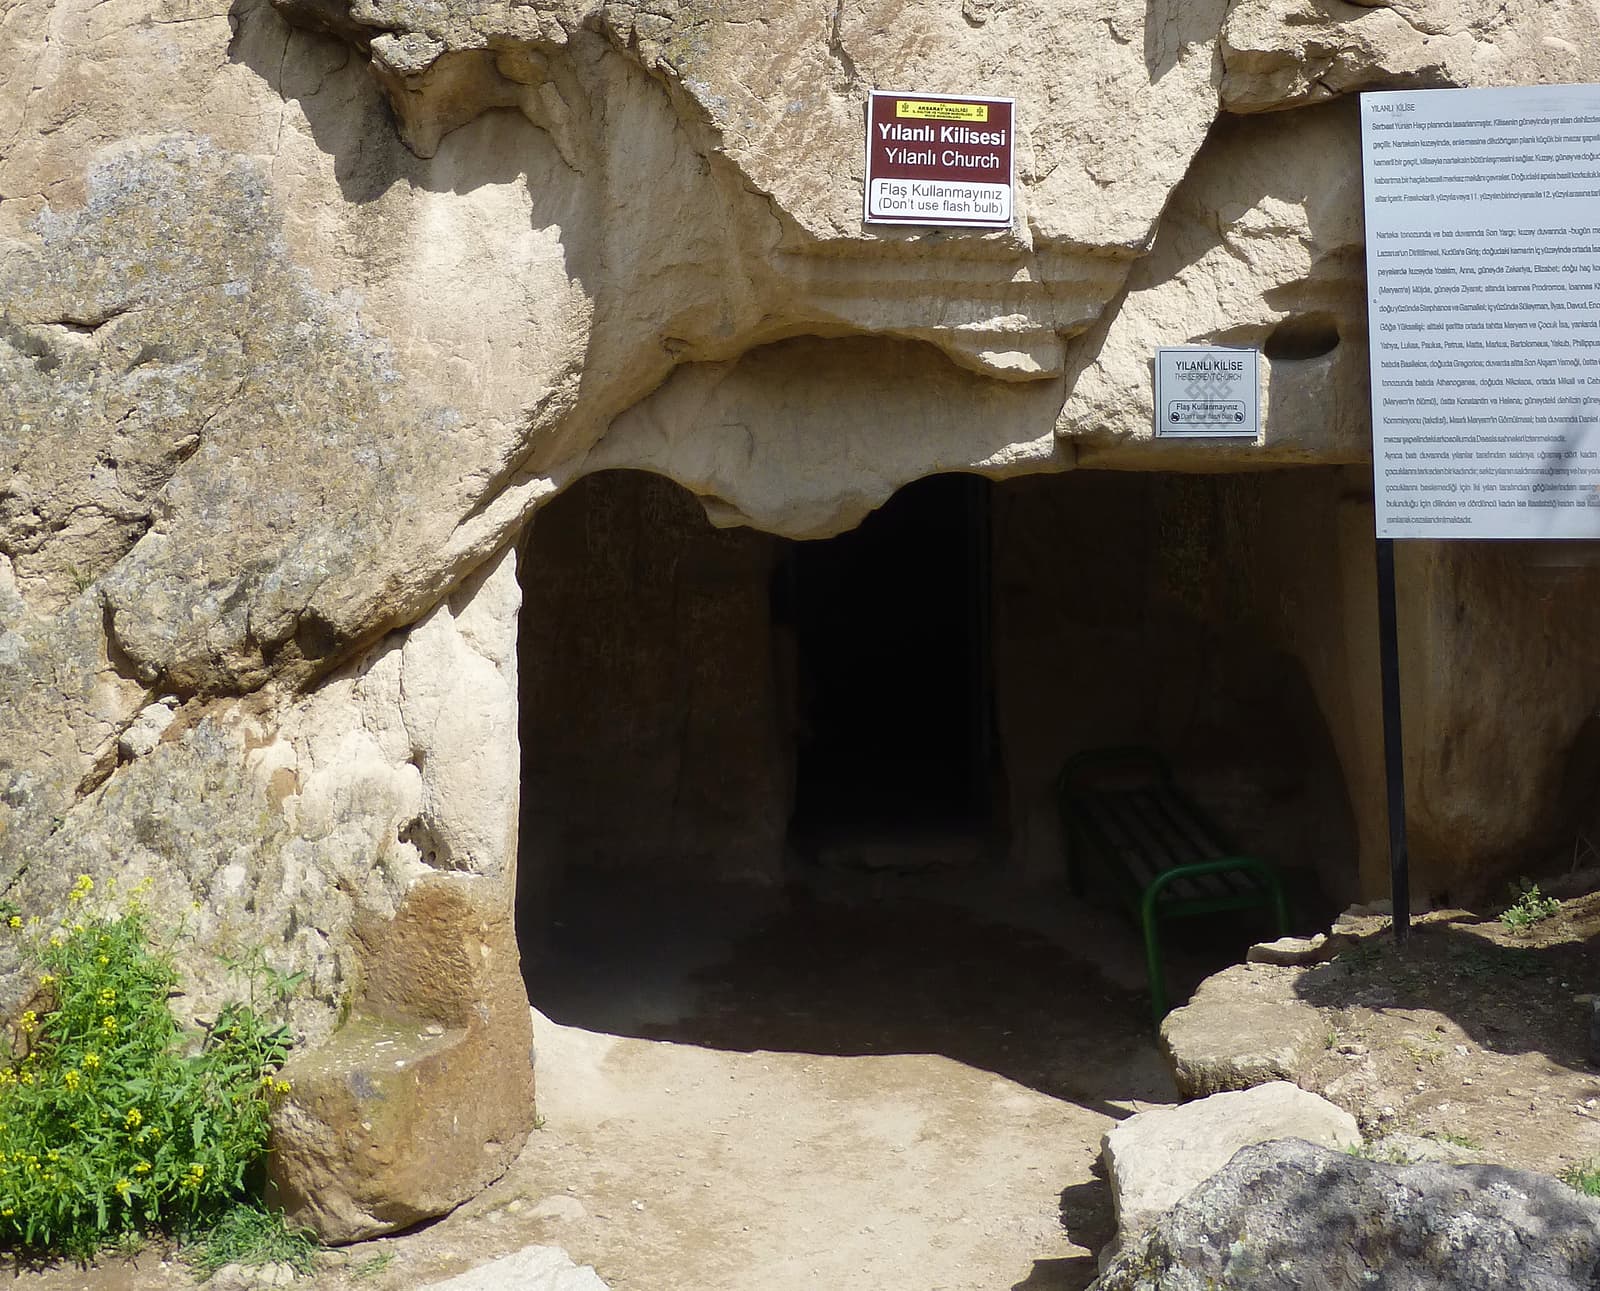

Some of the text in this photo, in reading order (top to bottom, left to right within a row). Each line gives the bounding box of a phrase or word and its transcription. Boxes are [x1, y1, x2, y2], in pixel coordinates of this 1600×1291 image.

[878, 122, 1006, 146] Yılanlı Kilisesi
[885, 147, 999, 169] Yılanlı Church
[880, 182, 1002, 202] Flaş Kullanmayınız
[878, 197, 1003, 216] (Don't use flash bulb)
[1176, 360, 1243, 371] YILANLI KİLİSE
[1175, 373, 1187, 381] THE
